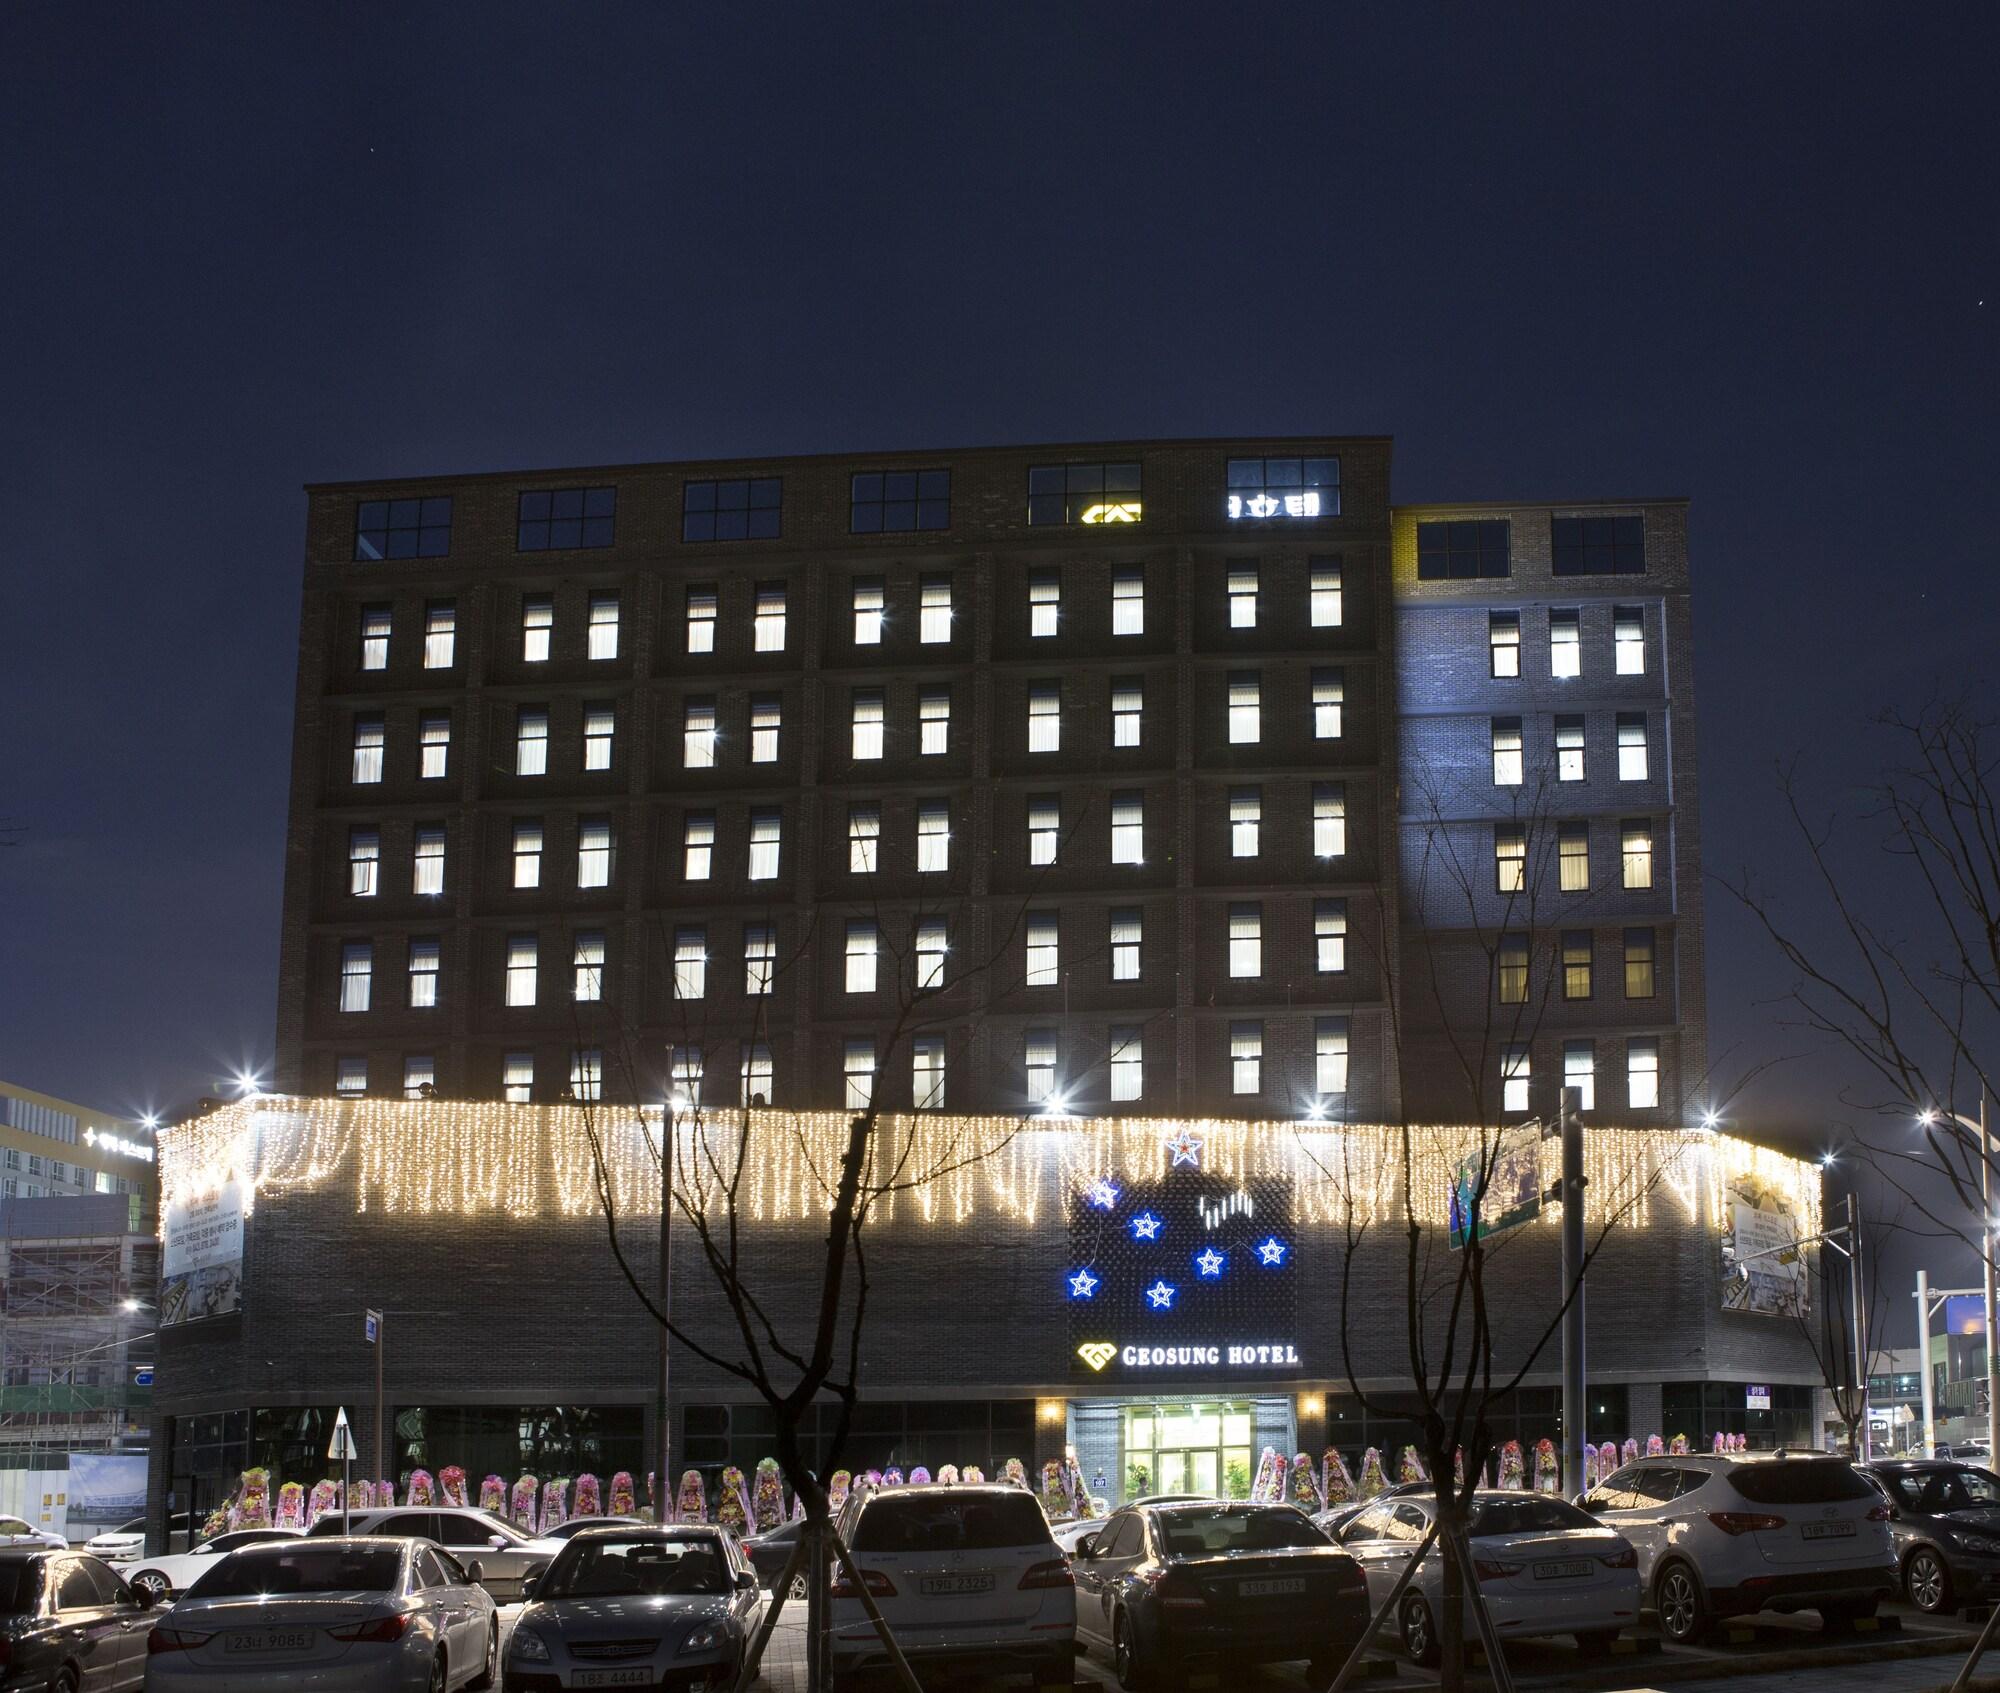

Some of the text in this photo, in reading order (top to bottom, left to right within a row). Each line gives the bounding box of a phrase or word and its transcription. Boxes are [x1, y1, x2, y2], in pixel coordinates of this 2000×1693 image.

[1122, 1345, 1298, 1366] GEOSUNG HOTEL
[957, 1577, 988, 1589] 2325
[268, 1634, 305, 1648] 9085
[610, 1671, 644, 1683] 4444
